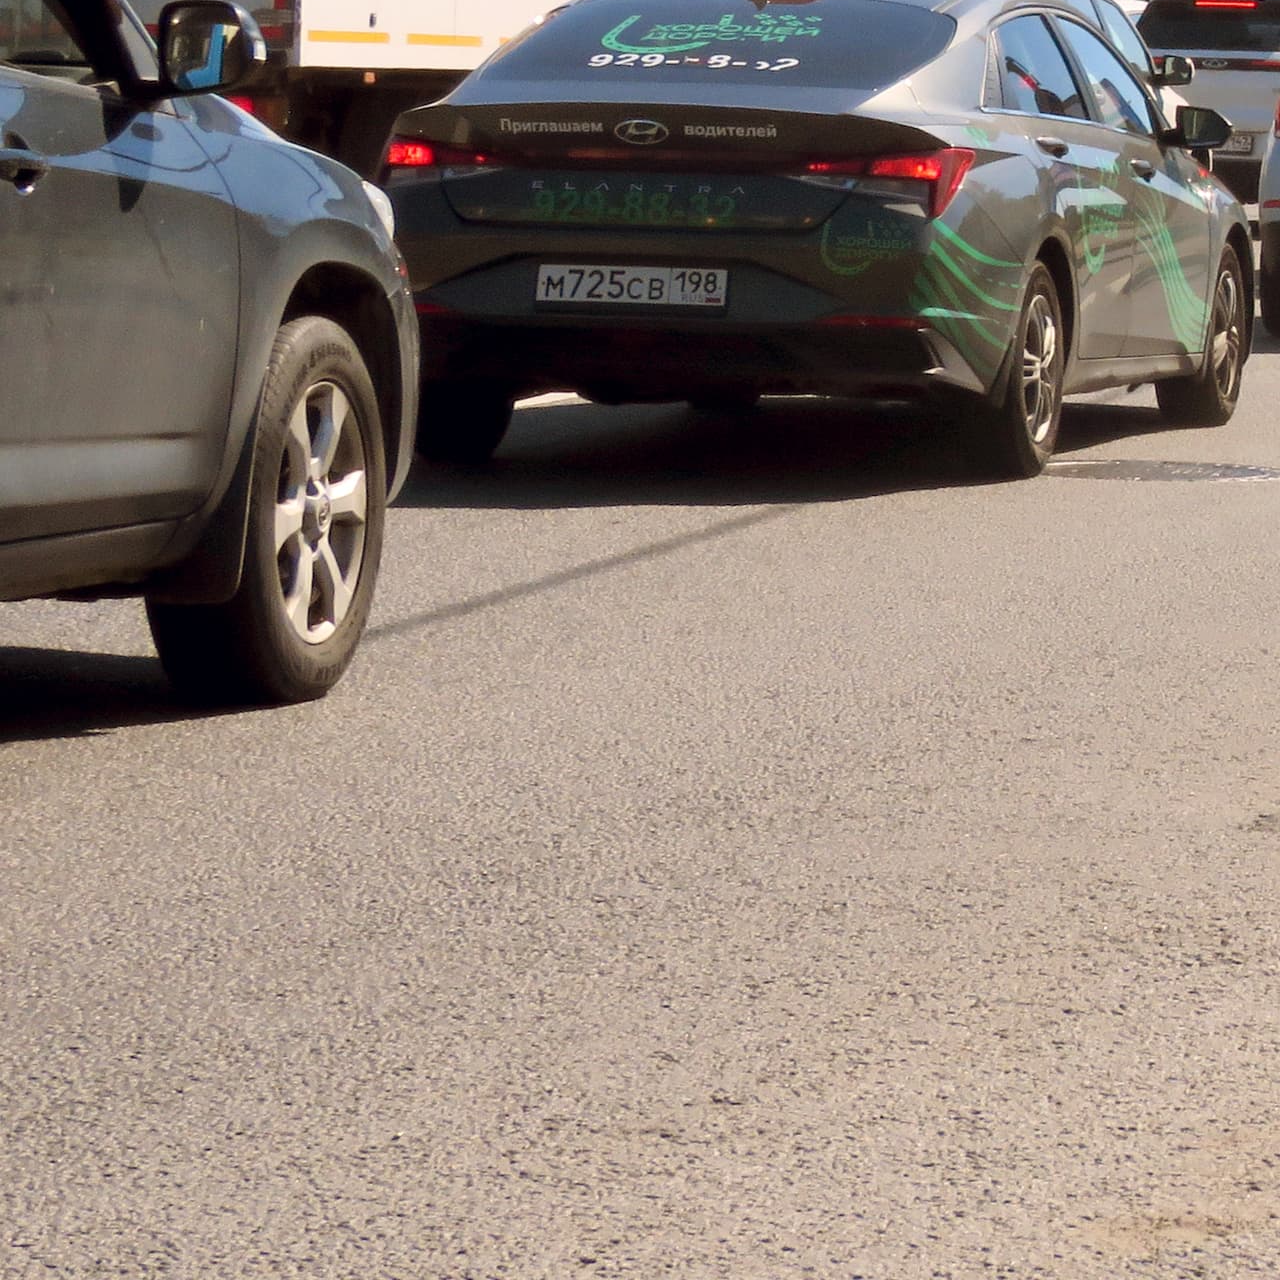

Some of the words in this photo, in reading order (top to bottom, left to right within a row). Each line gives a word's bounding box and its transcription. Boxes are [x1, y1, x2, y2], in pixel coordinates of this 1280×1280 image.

[500, 118, 604, 134] Приглашаем
[684, 123, 777, 138] водителей
[531, 180, 746, 194] ELANTRA
[545, 270, 665, 300] М725СВ
[675, 271, 718, 294] 198
